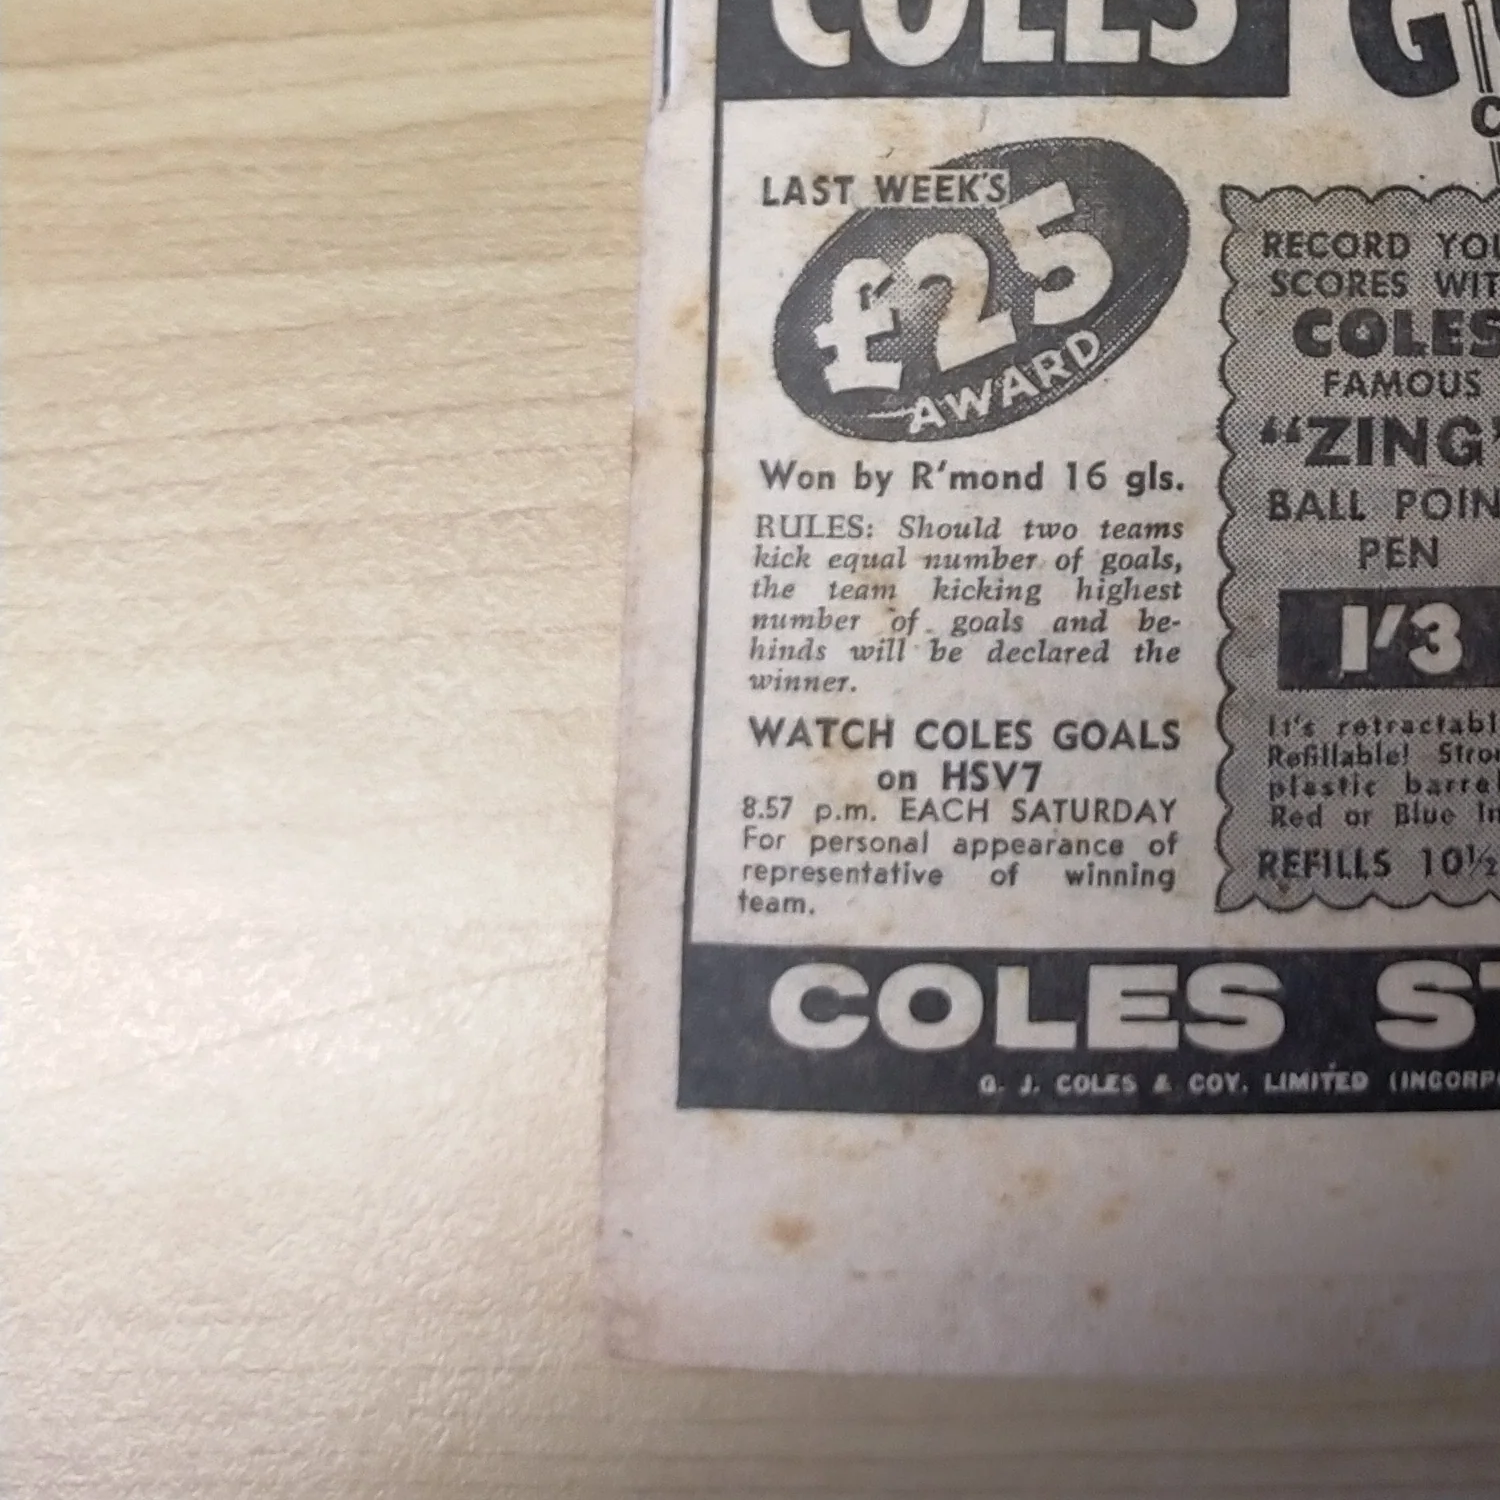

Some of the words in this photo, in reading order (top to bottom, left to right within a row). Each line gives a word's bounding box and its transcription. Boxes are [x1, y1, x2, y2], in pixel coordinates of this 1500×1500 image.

[762, 174, 854, 206] LAST
[875, 172, 1008, 204] WEEK'S
[1261, 230, 1410, 260] RECORD
[814, 180, 1113, 393] £25
[1270, 269, 1408, 298] SCORES
[908, 330, 1101, 434] AWARD
[1323, 369, 1481, 398] FAMOUS
[760, 459, 836, 491] Won
[855, 460, 893, 497] by
[912, 460, 1044, 491] R'mond
[1067, 460, 1107, 491] 16
[1126, 460, 1185, 497] gls.
[1267, 488, 1365, 521] BALL
[756, 514, 874, 539] RULES:
[900, 515, 1001, 539] Should
[1024, 519, 1078, 539] two
[1100, 519, 1184, 539] teams
[752, 545, 811, 569] kick
[828, 547, 905, 575] equal
[924, 547, 1037, 571] number
[1055, 546, 1083, 575] of
[1101, 547, 1183, 575] goals,
[1359, 536, 1438, 569] PEN
[751, 576, 794, 599] the
[828, 580, 898, 600] team
[933, 577, 1042, 606] kicking
[1076, 577, 1183, 605] highest
[751, 607, 860, 631] number
[891, 608, 920, 637] of
[951, 609, 1024, 637] goals
[1053, 610, 1107, 633] and
[1138, 609, 1181, 632] be-
[749, 637, 826, 662] hinds
[850, 638, 905, 663] will
[931, 638, 963, 664] be
[987, 639, 1110, 664] declared
[1135, 639, 1180, 664] the
[749, 670, 857, 693] winner.
[749, 716, 894, 750] WATCH
[915, 719, 1032, 751] COLES
[1053, 719, 1180, 751] GOALS
[1268, 713, 1315, 737] It's
[1267, 743, 1409, 768] Refillable!
[878, 768, 917, 790] on
[942, 760, 1042, 792] HSV7
[1269, 773, 1377, 800] plastic
[742, 796, 793, 820] 8.57
[816, 802, 877, 825] p.m.
[900, 798, 990, 822] EACH
[1011, 798, 1176, 824] SATURDAY
[1270, 803, 1323, 829] Red
[1344, 808, 1373, 827] or
[1395, 802, 1455, 827] Blue
[743, 825, 785, 850] For
[810, 830, 928, 856] personal
[953, 835, 1124, 860] appearance
[1148, 830, 1178, 856] of
[742, 861, 943, 887] representative
[990, 863, 1020, 887] of
[1066, 864, 1176, 892] winning
[1258, 849, 1391, 880] REFILLS
[738, 893, 815, 915] team.
[770, 962, 1286, 1052] COLES
[1020, 1074, 1040, 1095] J.
[1055, 1074, 1137, 1094] COLES
[1153, 1073, 1171, 1094] &
[1265, 1070, 1368, 1094] LIMITED
